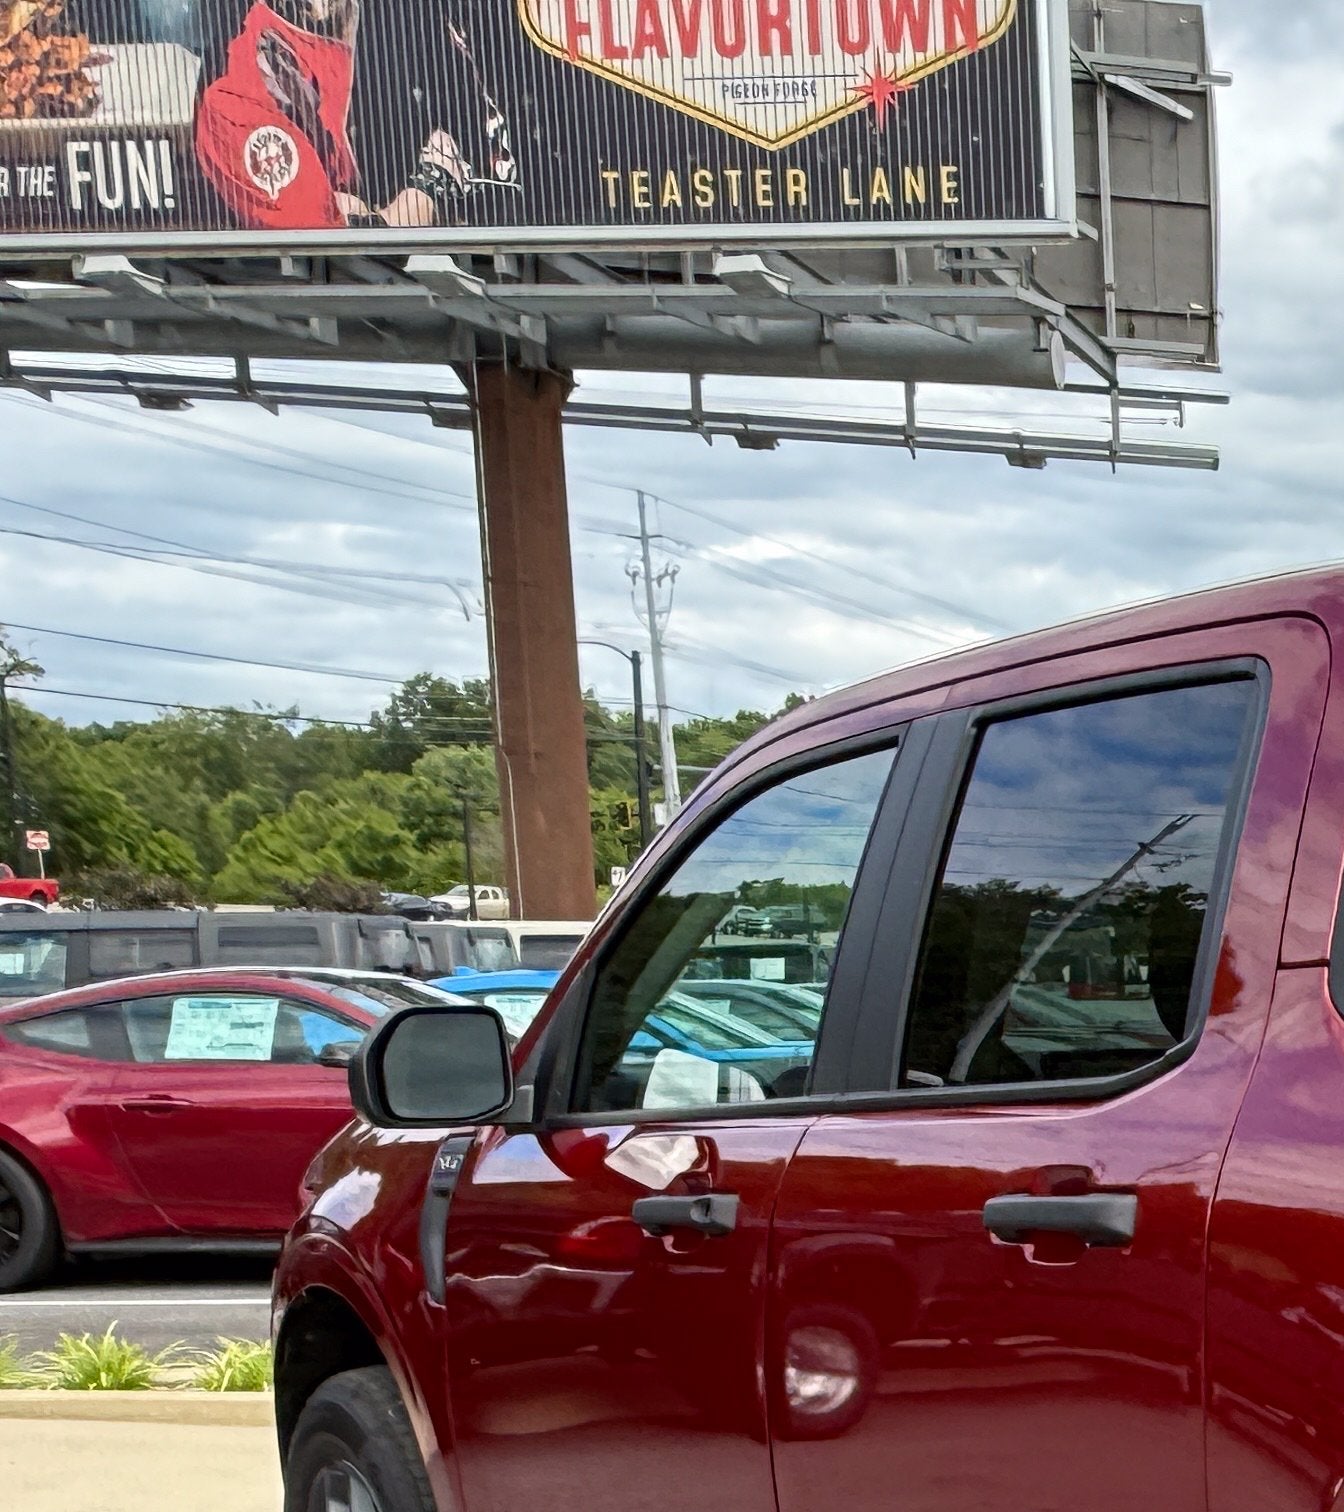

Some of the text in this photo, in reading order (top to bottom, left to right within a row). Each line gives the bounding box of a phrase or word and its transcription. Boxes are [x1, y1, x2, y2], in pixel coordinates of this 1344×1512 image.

[564, 0, 979, 61] FLAVORTOWN
[16, 166, 56, 197] THE
[67, 140, 175, 210] FUN!
[600, 165, 961, 209] TEASTER LANE
